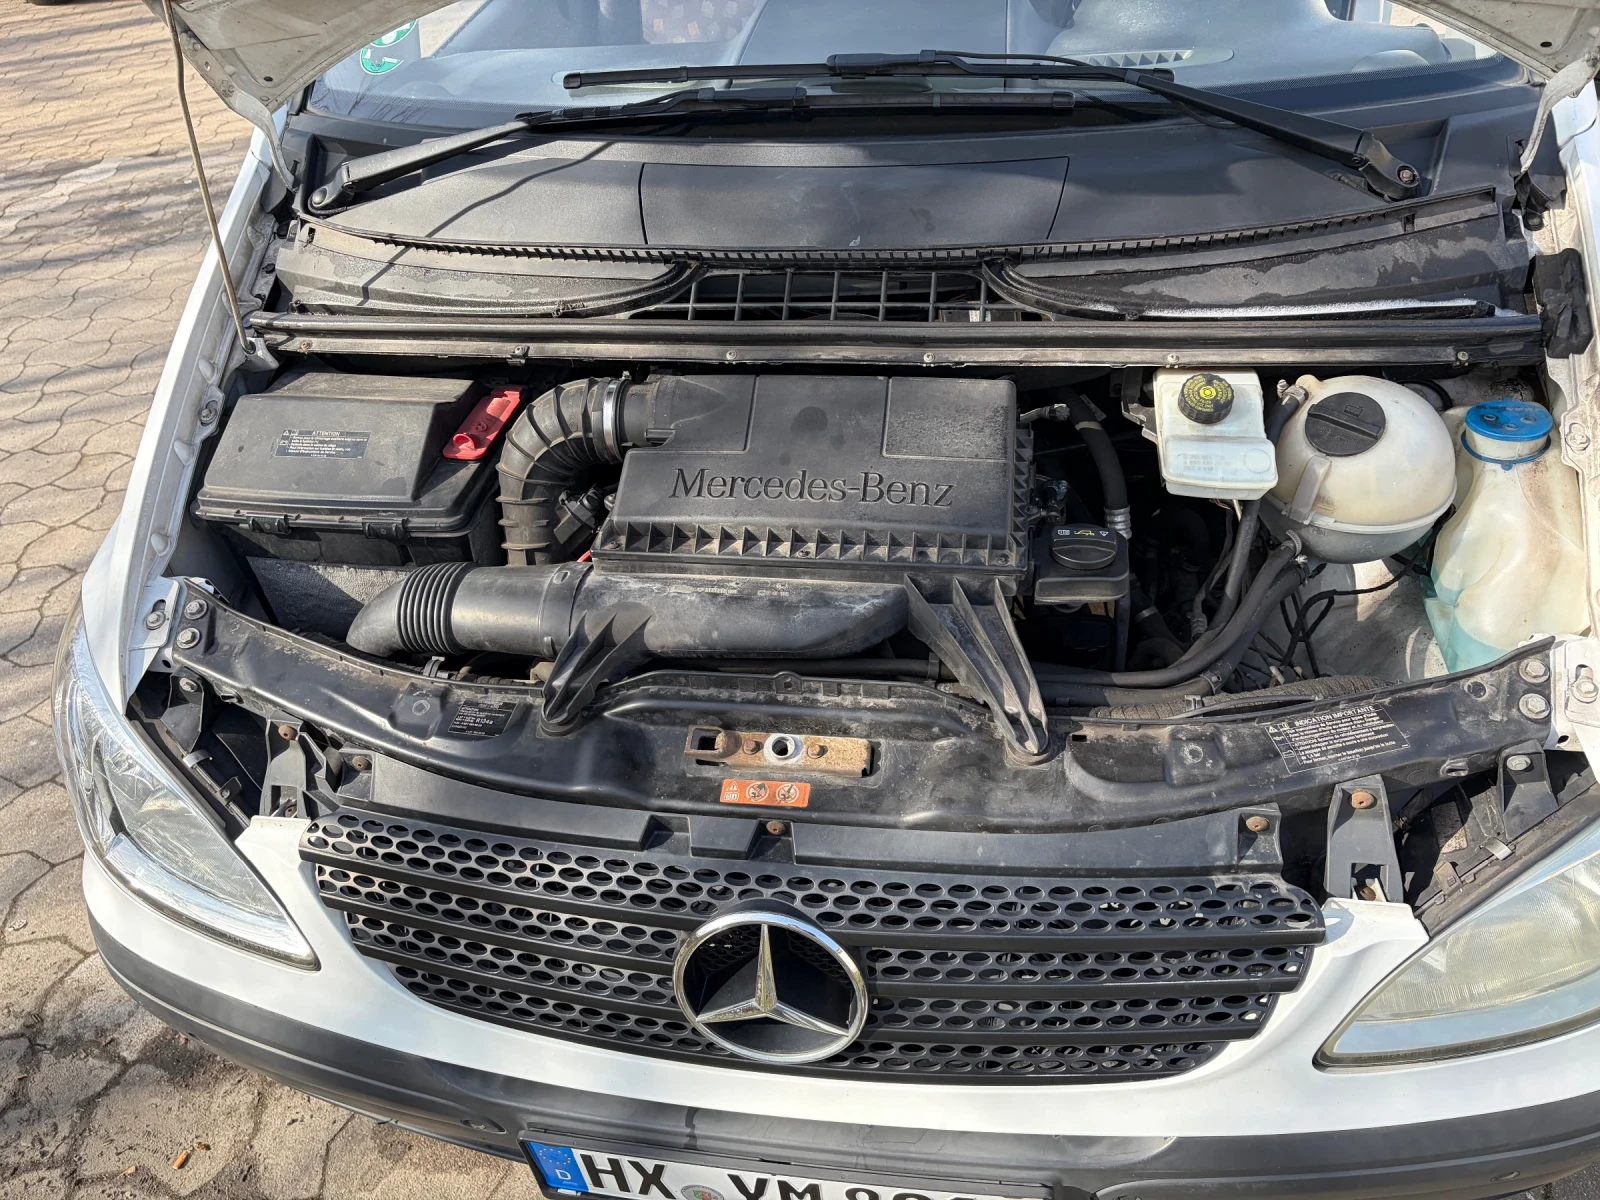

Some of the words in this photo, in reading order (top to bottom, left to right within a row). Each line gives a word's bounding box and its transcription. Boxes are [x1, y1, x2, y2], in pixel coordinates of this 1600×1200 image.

[669, 468, 954, 506] Mercedes-Benz
[1295, 715, 1332, 726] INDICATION
[1333, 706, 1374, 718] IMPORTANTE
[555, 1169, 571, 1180] D
[579, 1153, 677, 1200] HX
